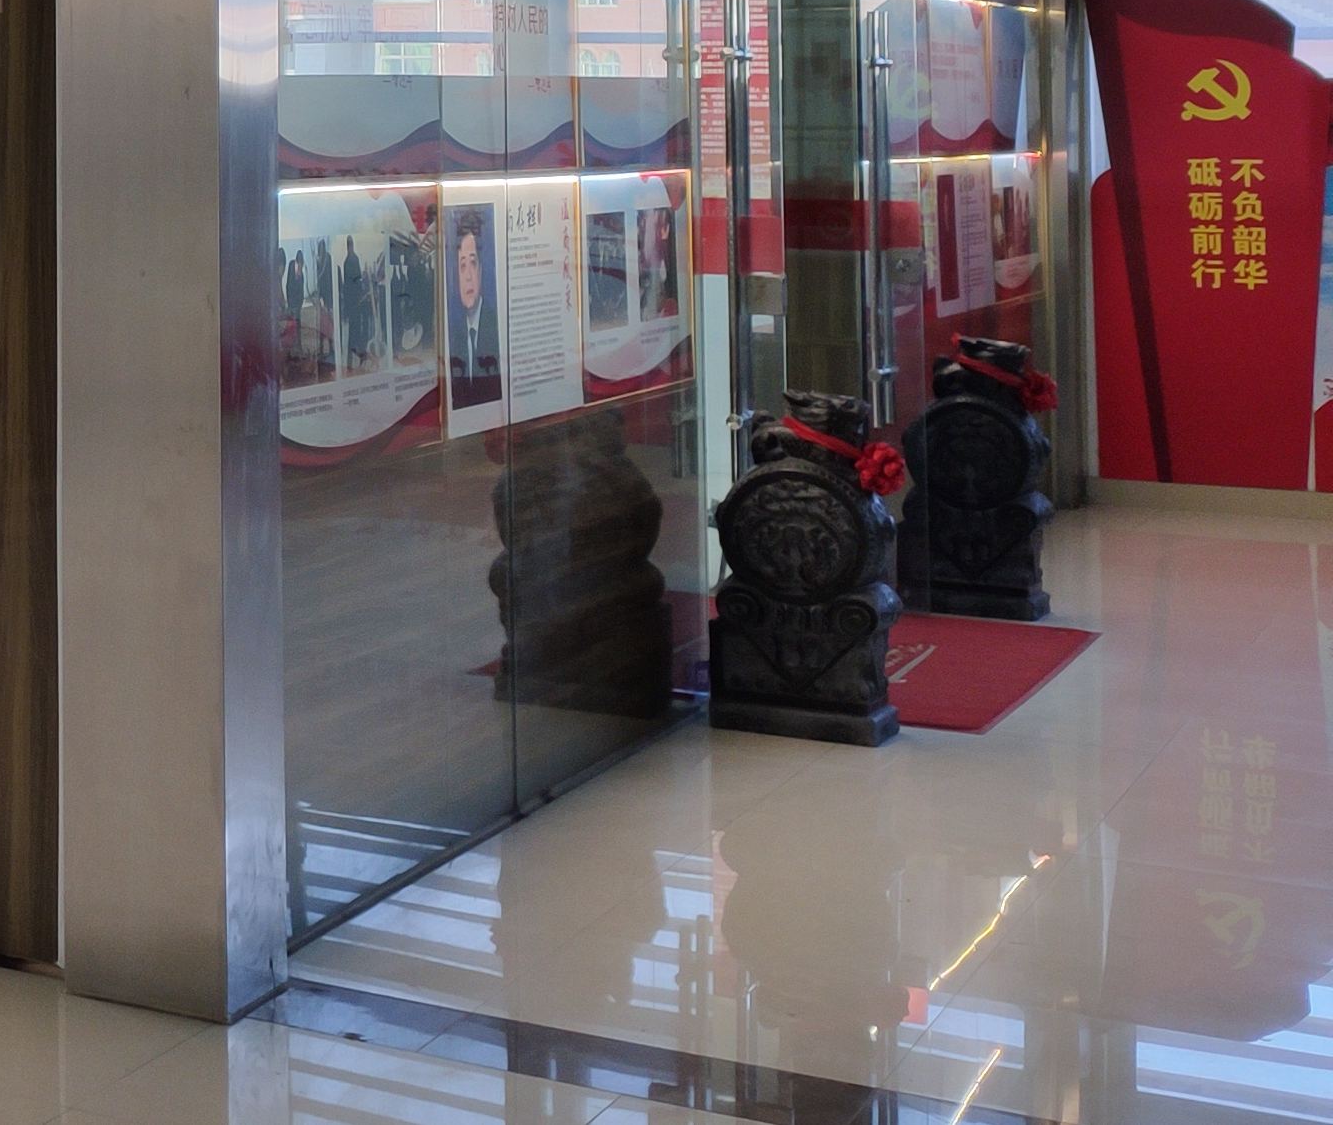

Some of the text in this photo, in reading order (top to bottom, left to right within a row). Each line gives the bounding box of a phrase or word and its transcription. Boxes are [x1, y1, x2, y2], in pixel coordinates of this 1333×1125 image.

[1186, 157, 1227, 289] 砥砺前行
[1230, 158, 1269, 291] 不负韶华
